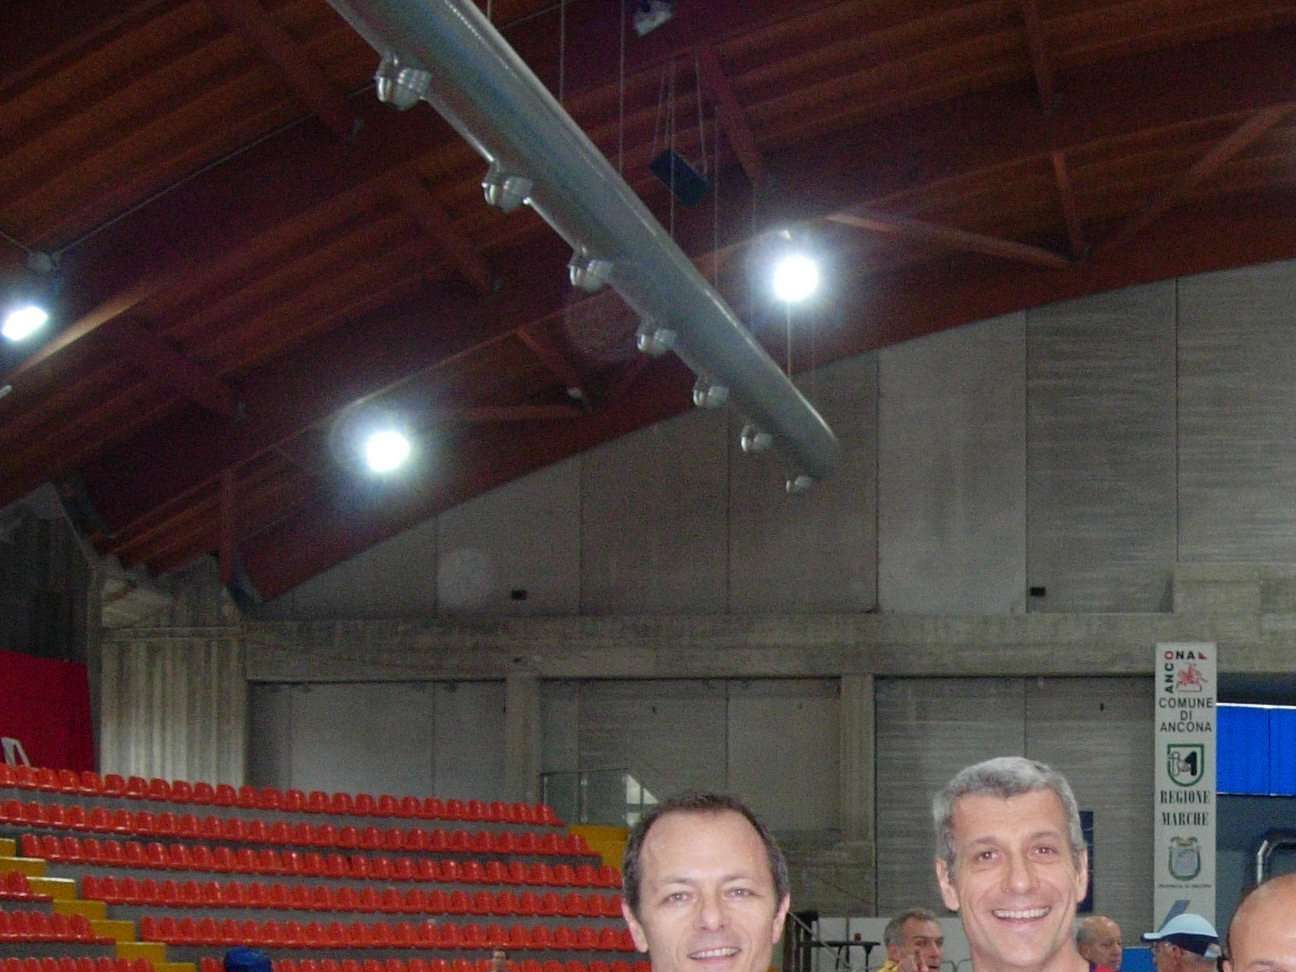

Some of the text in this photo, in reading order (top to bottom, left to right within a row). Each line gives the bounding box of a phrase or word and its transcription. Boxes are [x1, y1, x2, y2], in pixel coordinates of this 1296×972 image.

[1158, 697, 1214, 709] COMUNE
[1180, 710, 1193, 721] DI
[1159, 721, 1213, 733] ANCONA
[1159, 790, 1210, 804] REGIONE
[1161, 811, 1209, 826] MARCHE
